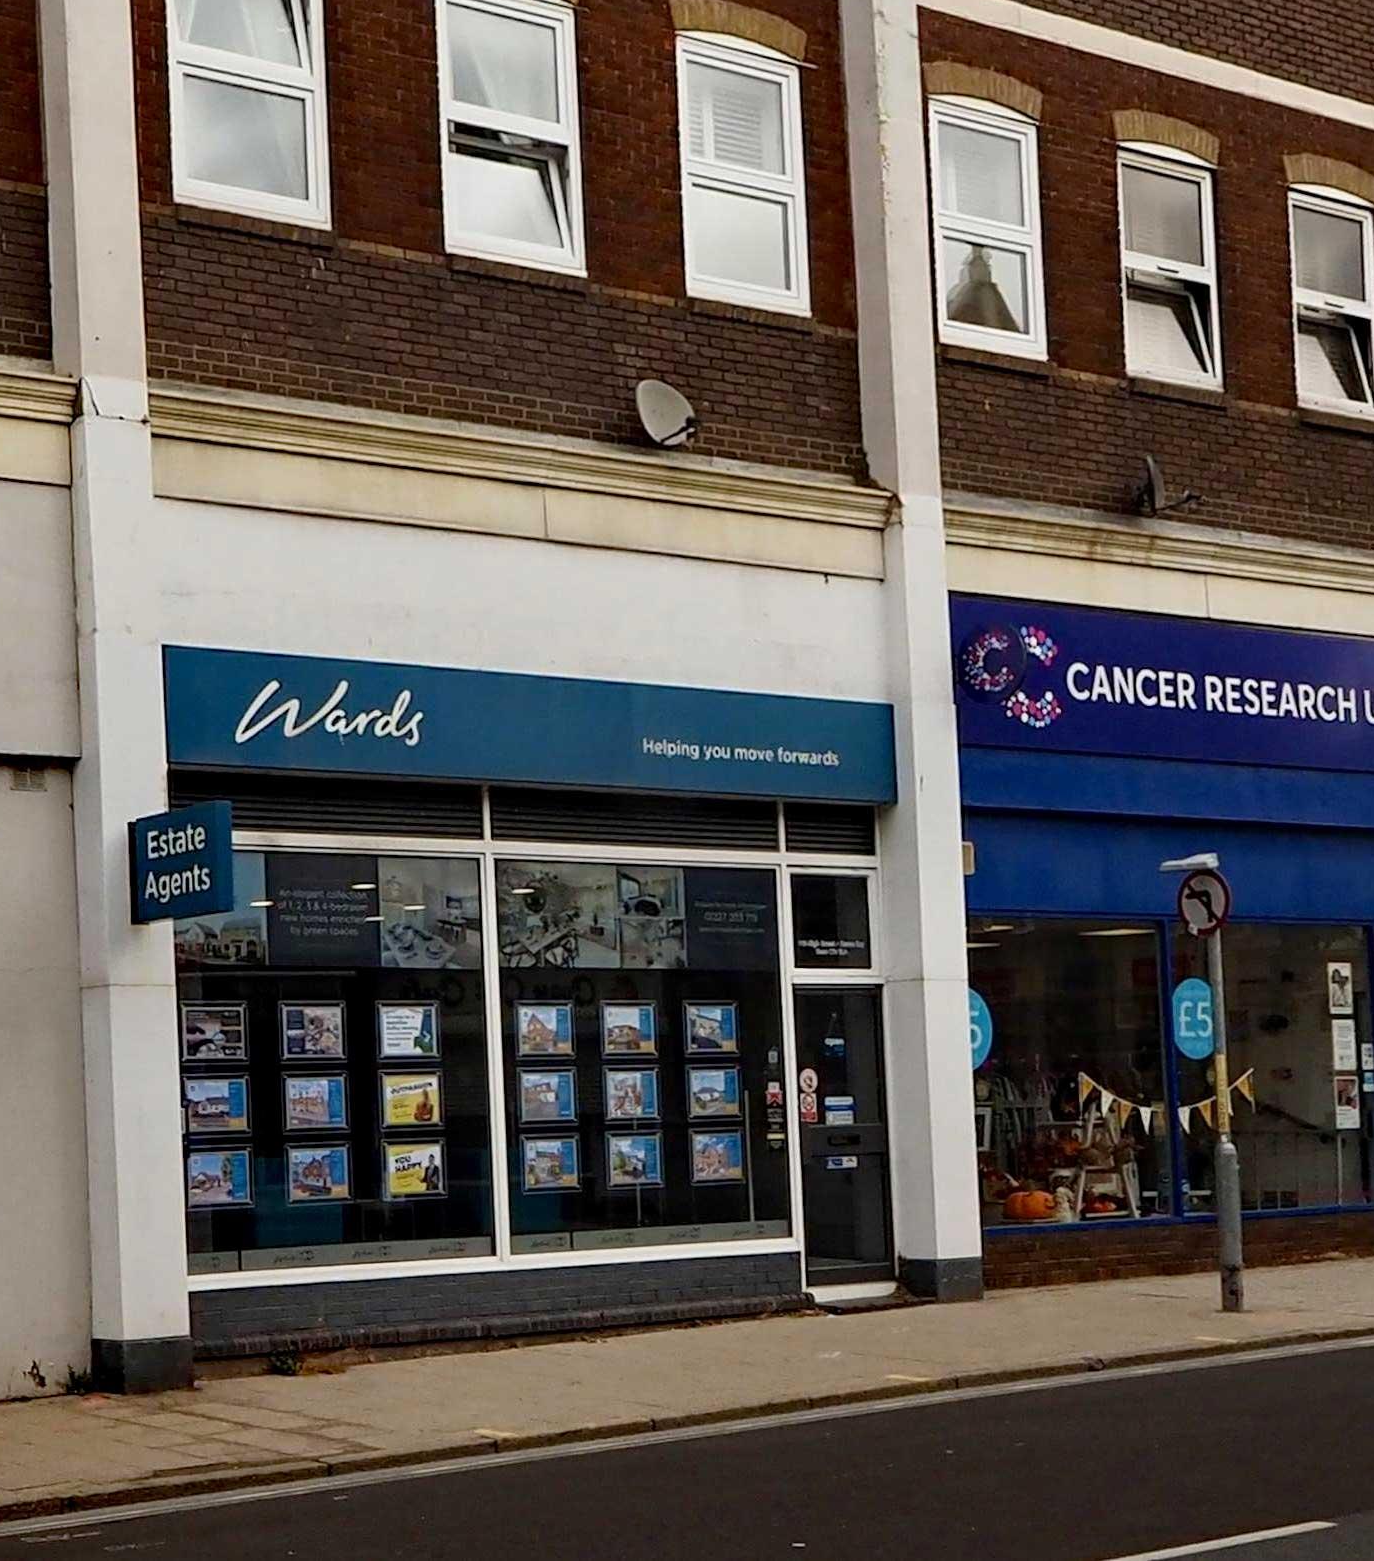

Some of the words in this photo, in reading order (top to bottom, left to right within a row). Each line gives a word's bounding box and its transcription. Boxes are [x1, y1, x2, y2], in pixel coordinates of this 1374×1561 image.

[1066, 661, 1197, 710] CANCER
[1204, 674, 1358, 724] RESEARCH
[234, 679, 424, 746] Wards
[642, 738, 700, 760] Helping
[702, 746, 731, 761] you
[734, 748, 774, 763] move
[777, 746, 840, 767] forwards
[147, 823, 207, 860] Estate
[144, 863, 211, 904] Agents
[1178, 1001, 1214, 1037] £5
